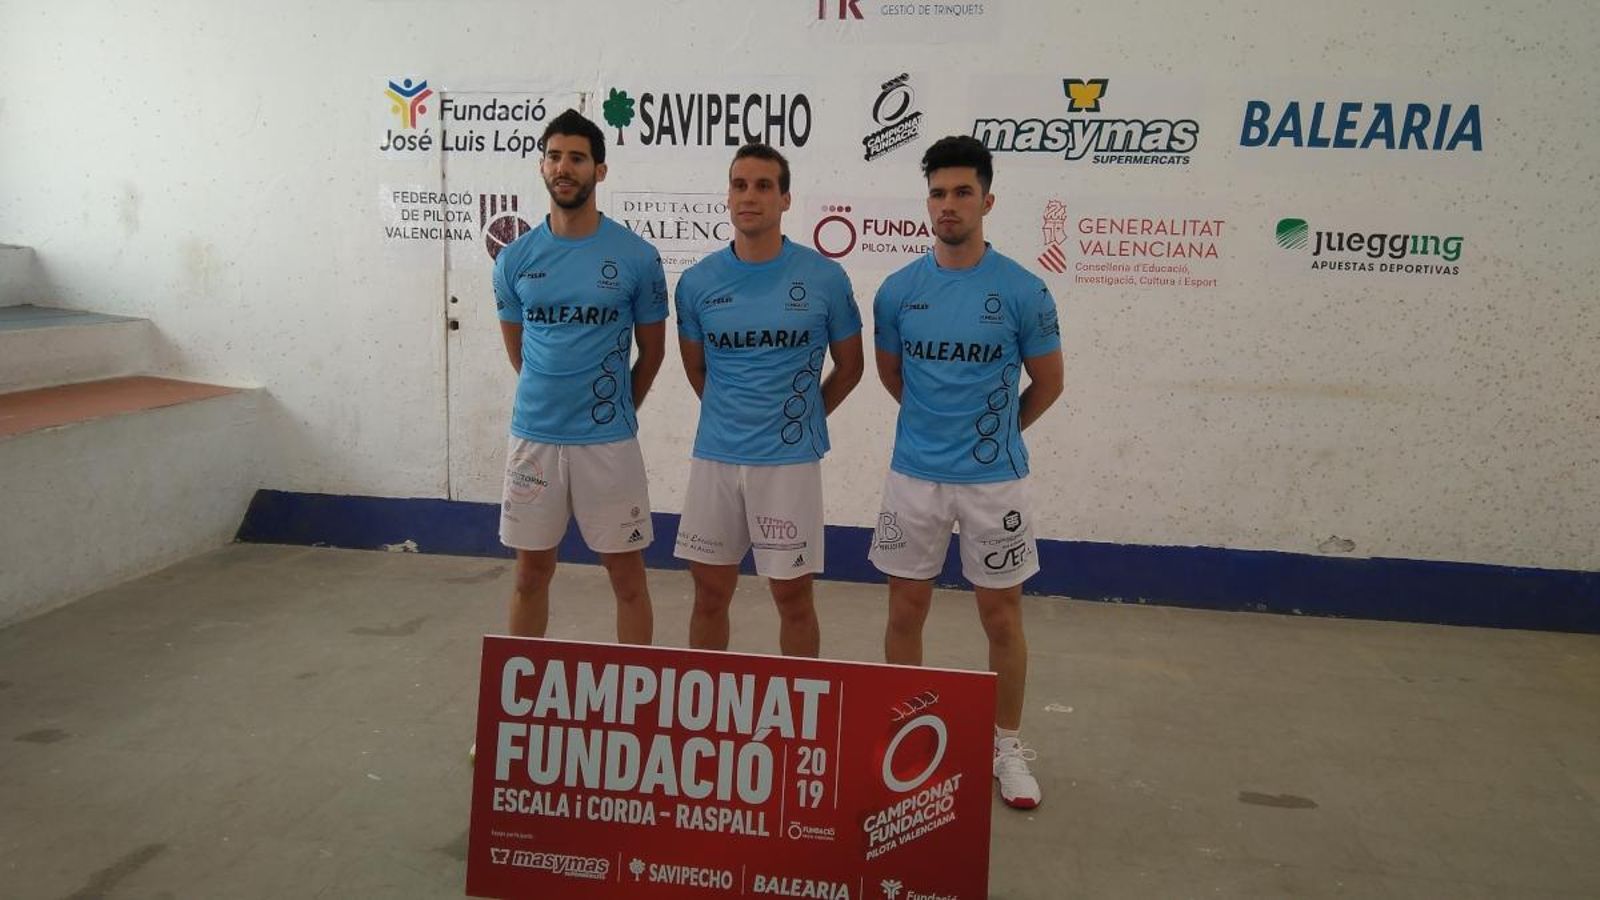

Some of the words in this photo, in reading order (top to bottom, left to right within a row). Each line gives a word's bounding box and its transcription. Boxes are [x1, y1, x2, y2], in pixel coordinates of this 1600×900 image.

[918, 5, 931, 16] DE
[439, 97, 547, 122] Fundació
[639, 92, 812, 148] SAVIPECHO
[380, 128, 433, 152] José
[441, 129, 486, 152] Luis
[973, 118, 1199, 160] masymas
[1092, 154, 1191, 165] SUPERMERCATS
[392, 191, 473, 206] FEDERACIÓ
[401, 209, 420, 222] DE
[423, 209, 473, 223] PILOTA
[862, 218, 936, 238] FUNDA
[1078, 218, 1226, 237] GENERALITAT
[385, 226, 473, 242] VALENCIANA
[861, 243, 898, 253] PILOTA
[1078, 239, 1220, 259] VALENCIANA
[1312, 231, 1465, 263] juegging
[1311, 260, 1374, 272] APUESTAS
[1379, 263, 1460, 275] DEPORTIVAS
[1139, 276, 1175, 286] Cultura
[1184, 277, 1217, 288] Esport
[500, 656, 830, 741] CAMPIONAT
[494, 721, 774, 805] FUNDACIÓ
[796, 746, 827, 777] 20
[796, 779, 825, 809] 19
[863, 773, 963, 833] CAMPIONAT
[492, 787, 571, 818] ESCALA
[575, 796, 583, 820] i
[587, 796, 656, 827] CORDA
[675, 804, 770, 837] RASPALL
[865, 839, 897, 861] PILOTA
[899, 812, 956, 845] VALENCIANA
[512, 850, 610, 874] masymas
[649, 863, 733, 890] SAVIPECHO
